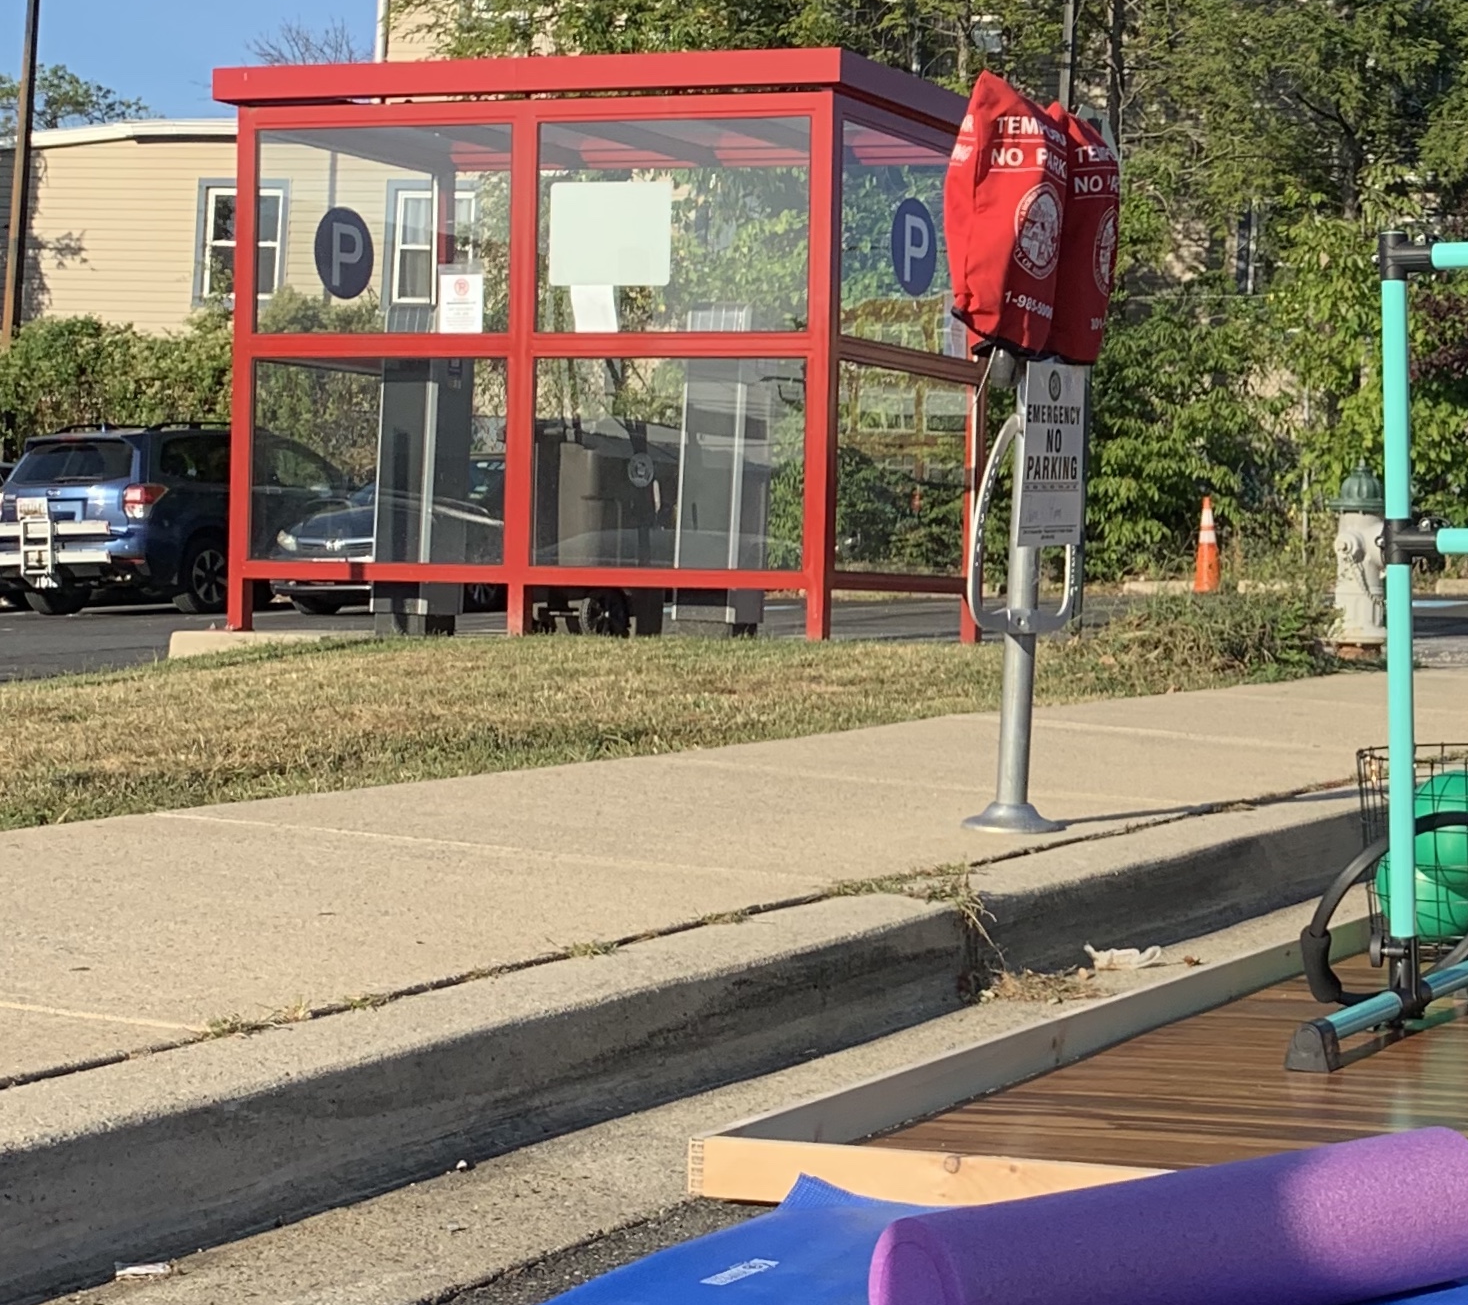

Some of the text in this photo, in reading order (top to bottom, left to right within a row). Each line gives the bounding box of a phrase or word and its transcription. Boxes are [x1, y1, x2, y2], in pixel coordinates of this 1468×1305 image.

[991, 147, 1024, 166] NO
[1035, 147, 1067, 179] PARK
[1074, 174, 1103, 193] NO
[332, 222, 363, 286] P
[904, 213, 929, 282] P
[1027, 404, 1081, 425] EMERGENCY
[1046, 428, 1062, 453] NO
[1026, 455, 1078, 480] PARKING
